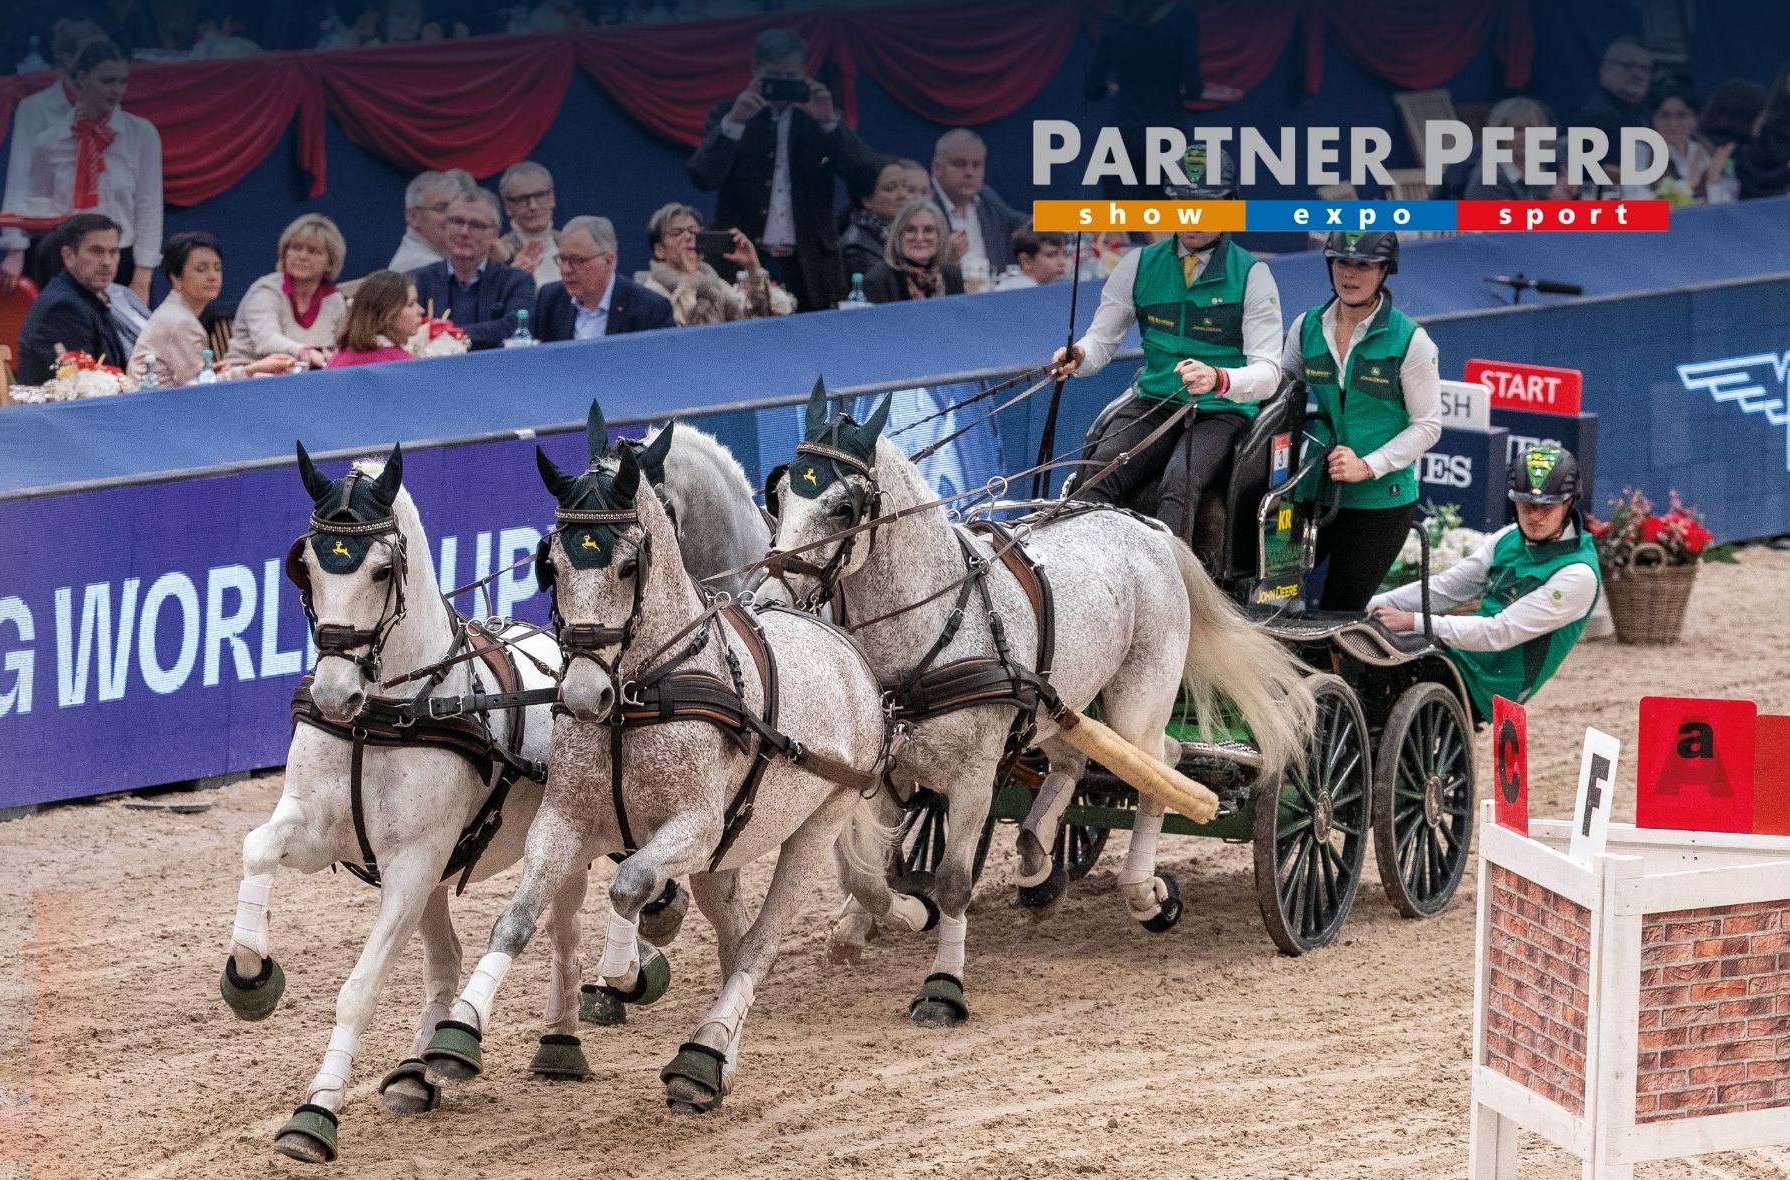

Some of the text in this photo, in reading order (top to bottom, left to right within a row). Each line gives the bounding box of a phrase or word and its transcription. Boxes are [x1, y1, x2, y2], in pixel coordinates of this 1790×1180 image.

[1480, 370, 1562, 404] START
[1277, 508, 1292, 530] KR
[55, 557, 317, 709] WORL
[440, 526, 546, 623] UP
[1256, 584, 1299, 605] JOHN DEERE
[1498, 719, 1520, 805] C
[1581, 752, 1611, 838] F
